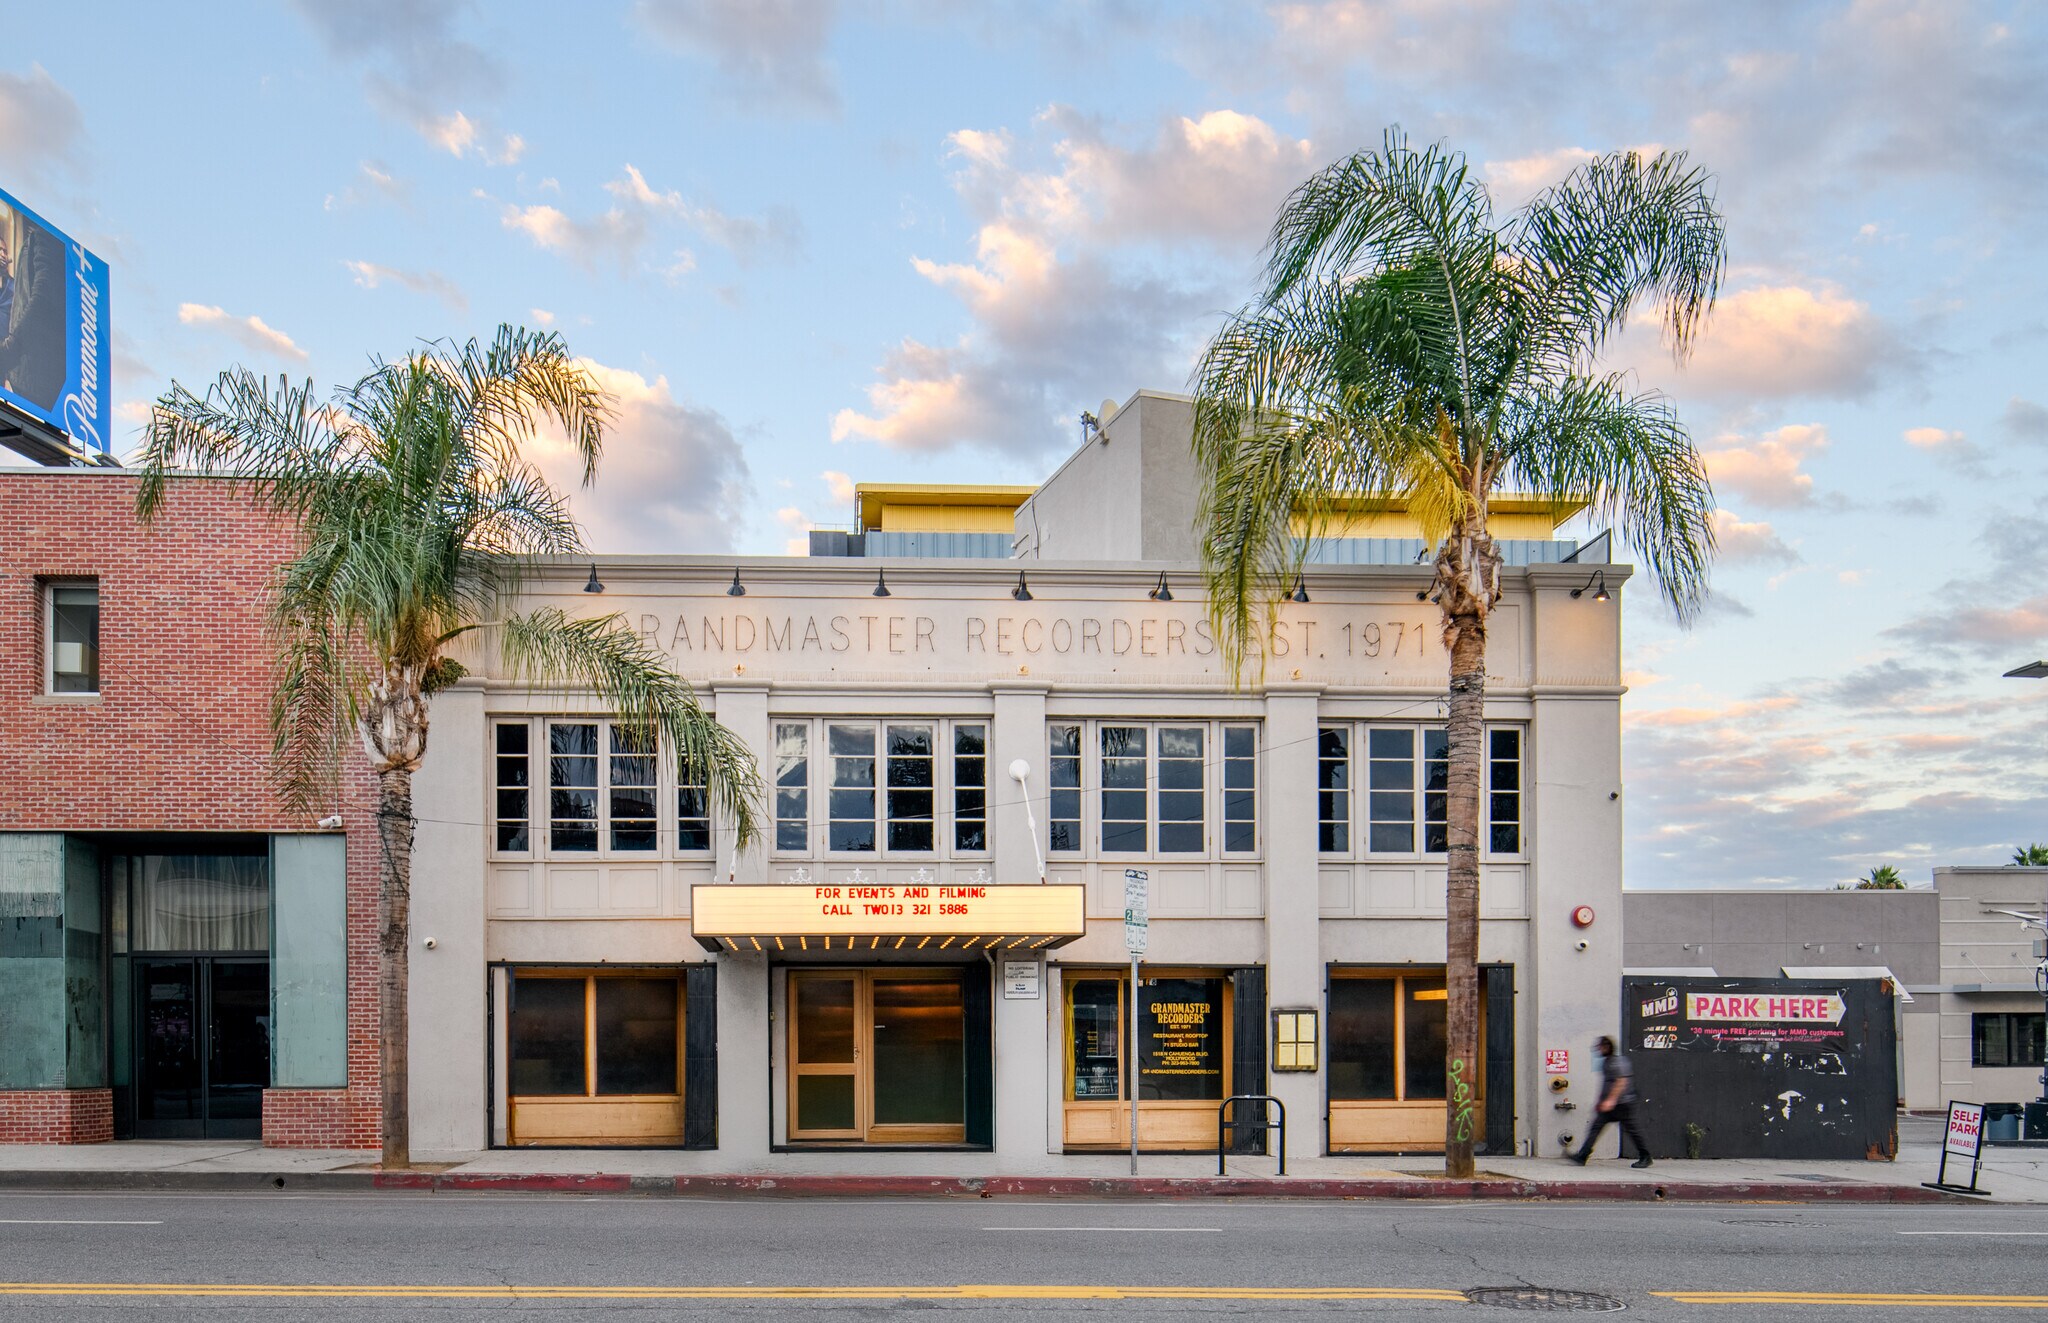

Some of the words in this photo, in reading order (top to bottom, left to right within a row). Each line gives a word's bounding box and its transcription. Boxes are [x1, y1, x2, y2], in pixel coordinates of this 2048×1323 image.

[966, 616, 1214, 656] RECORDERS
[1342, 621, 1425, 658] 1971
[815, 887, 841, 899] FOR
[849, 887, 896, 899] EVENTS
[903, 887, 929, 899] AND
[939, 887, 986, 899] FILMING
[822, 904, 853, 916] CALL
[912, 904, 931, 915] 321
[939, 904, 969, 915] 5886
[1151, 1003, 1210, 1013] GRANDMASTER
[1641, 996, 1678, 1018] MMD
[1696, 997, 1760, 1017] PARK
[1769, 998, 1828, 1018] HERE
[1158, 1014, 1204, 1023] RECORDERS
[1703, 1027, 1729, 1035] minute
[1748, 1028, 1777, 1037] parking
[1777, 1028, 1789, 1036] for
[1789, 1028, 1808, 1036] MMD
[1809, 1029, 1844, 1037] customers
[1953, 1110, 1979, 1122] SELF
[1950, 1122, 1979, 1136] PARK
[1950, 1138, 1976, 1148] AVAILABLE
